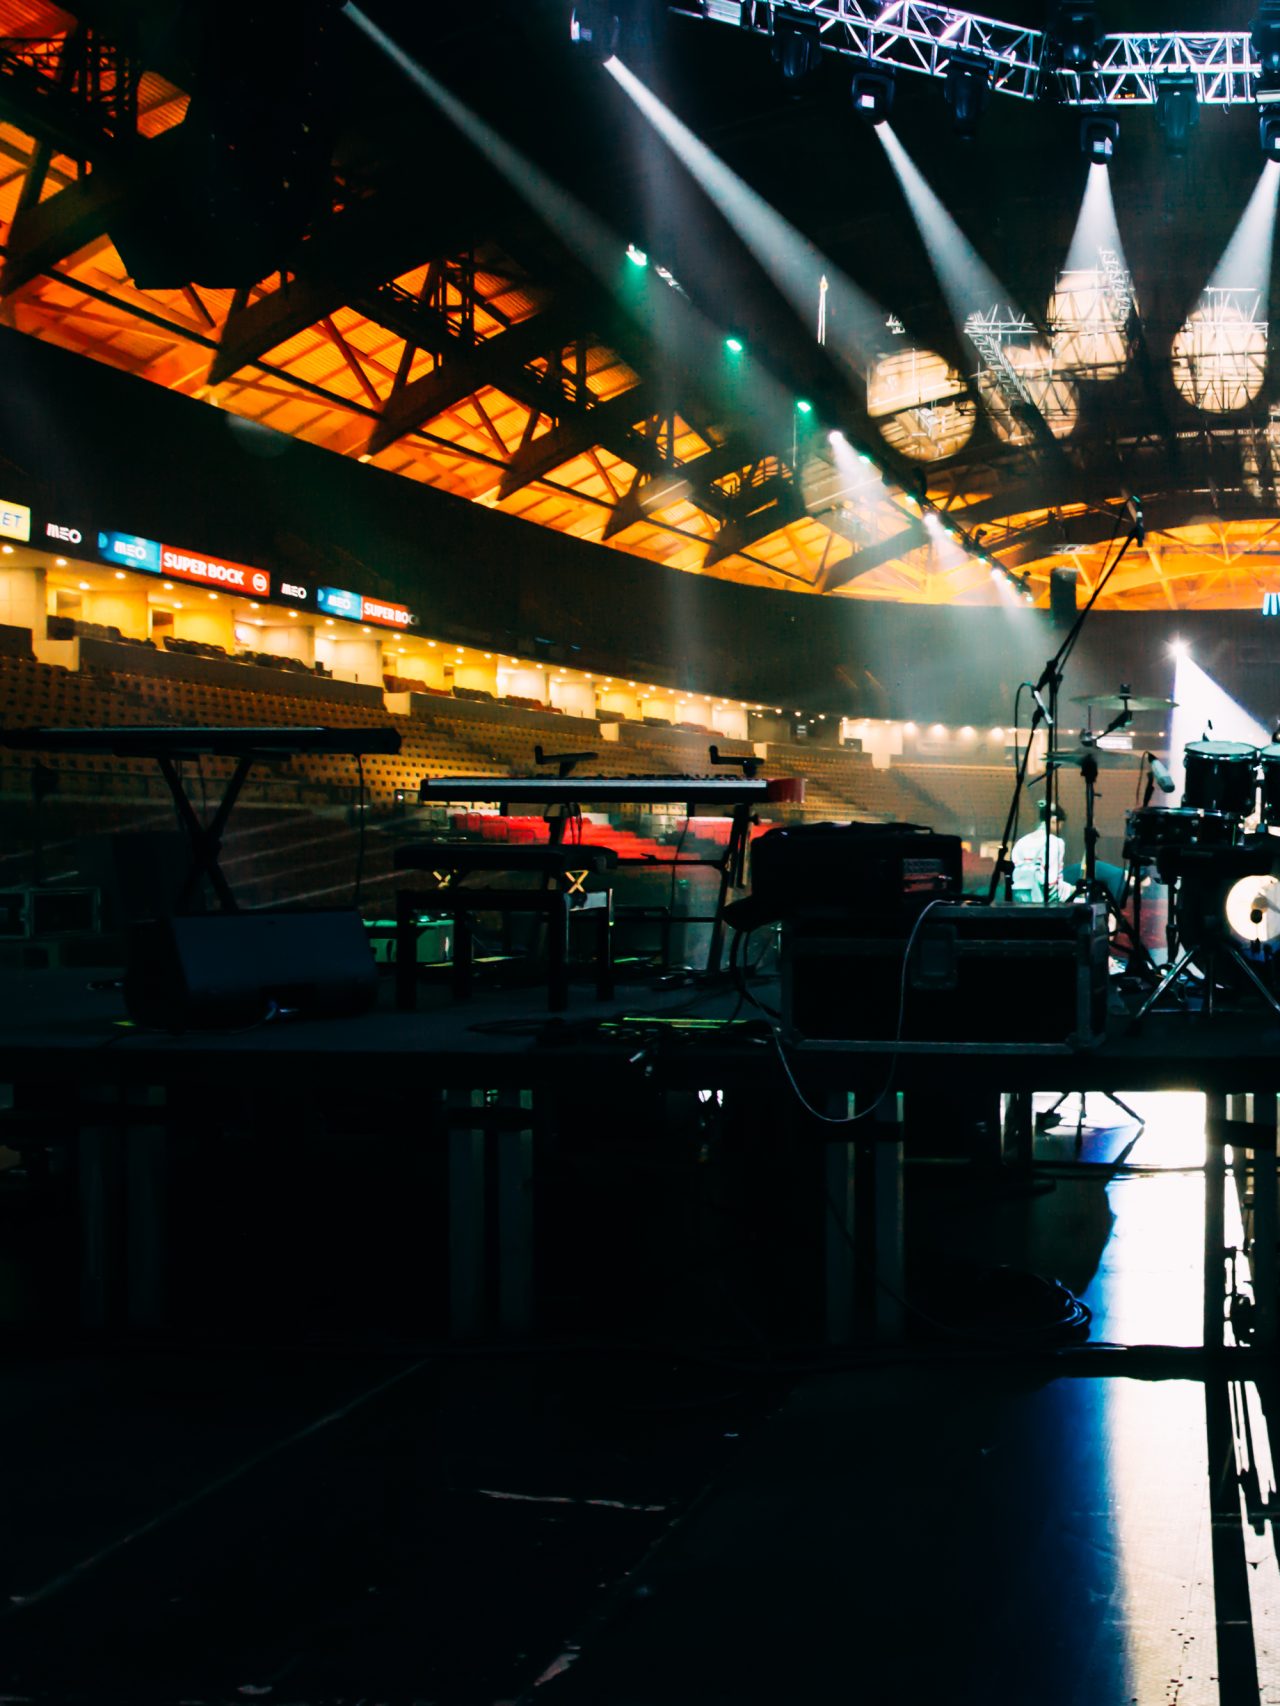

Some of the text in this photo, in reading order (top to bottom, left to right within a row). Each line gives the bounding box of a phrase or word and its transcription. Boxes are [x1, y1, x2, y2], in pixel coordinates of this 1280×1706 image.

[45, 522, 83, 544] MEO
[113, 540, 147, 560] MEO
[163, 551, 245, 587] SUPER BOCK
[281, 582, 307, 600] MEO
[327, 594, 352, 610] MEO
[363, 602, 395, 620] SUPER
